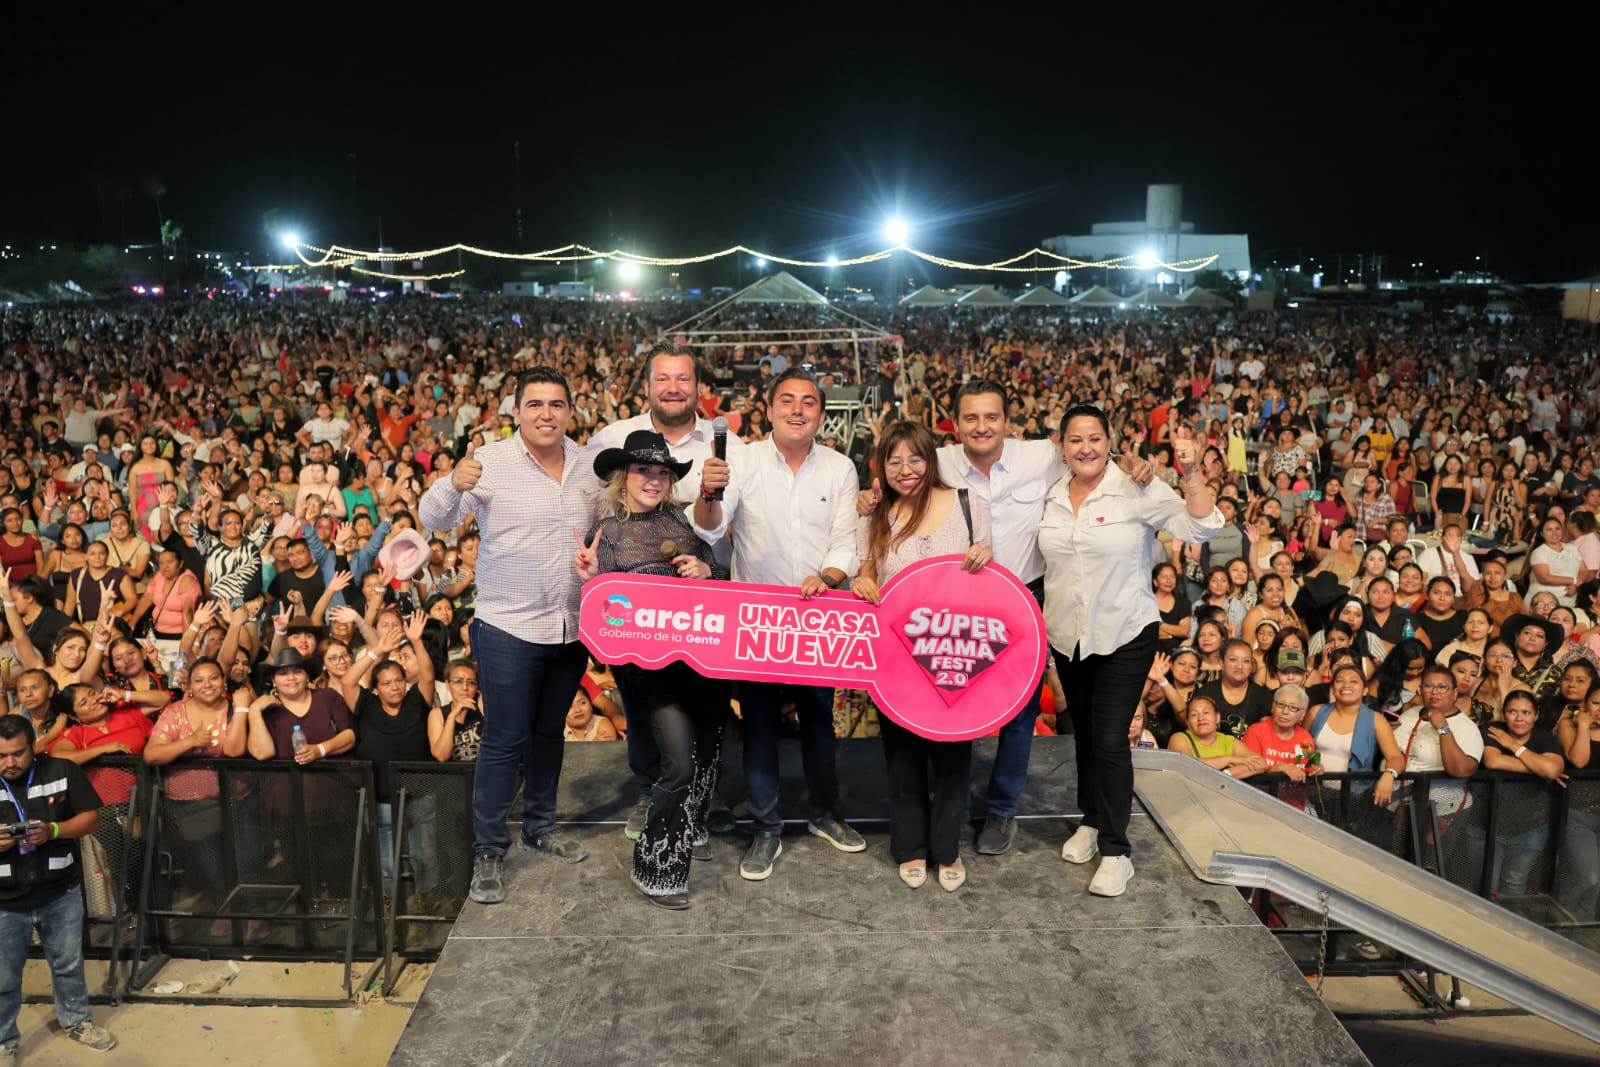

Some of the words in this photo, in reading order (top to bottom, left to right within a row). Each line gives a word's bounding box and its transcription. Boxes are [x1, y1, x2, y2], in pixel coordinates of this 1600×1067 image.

[738, 603, 801, 631] UNA
[801, 608, 881, 638] CASA
[904, 607, 1009, 644] SÚPER
[598, 627, 652, 641] Gobierno
[654, 631, 670, 642] de
[671, 632, 683, 643] la
[685, 633, 721, 646] Gente
[735, 627, 878, 670] NUEVA
[911, 637, 996, 663] MAMÁ
[930, 655, 977, 673] FEST
[936, 671, 967, 686] 2.0
[454, 725, 481, 746] EEK
